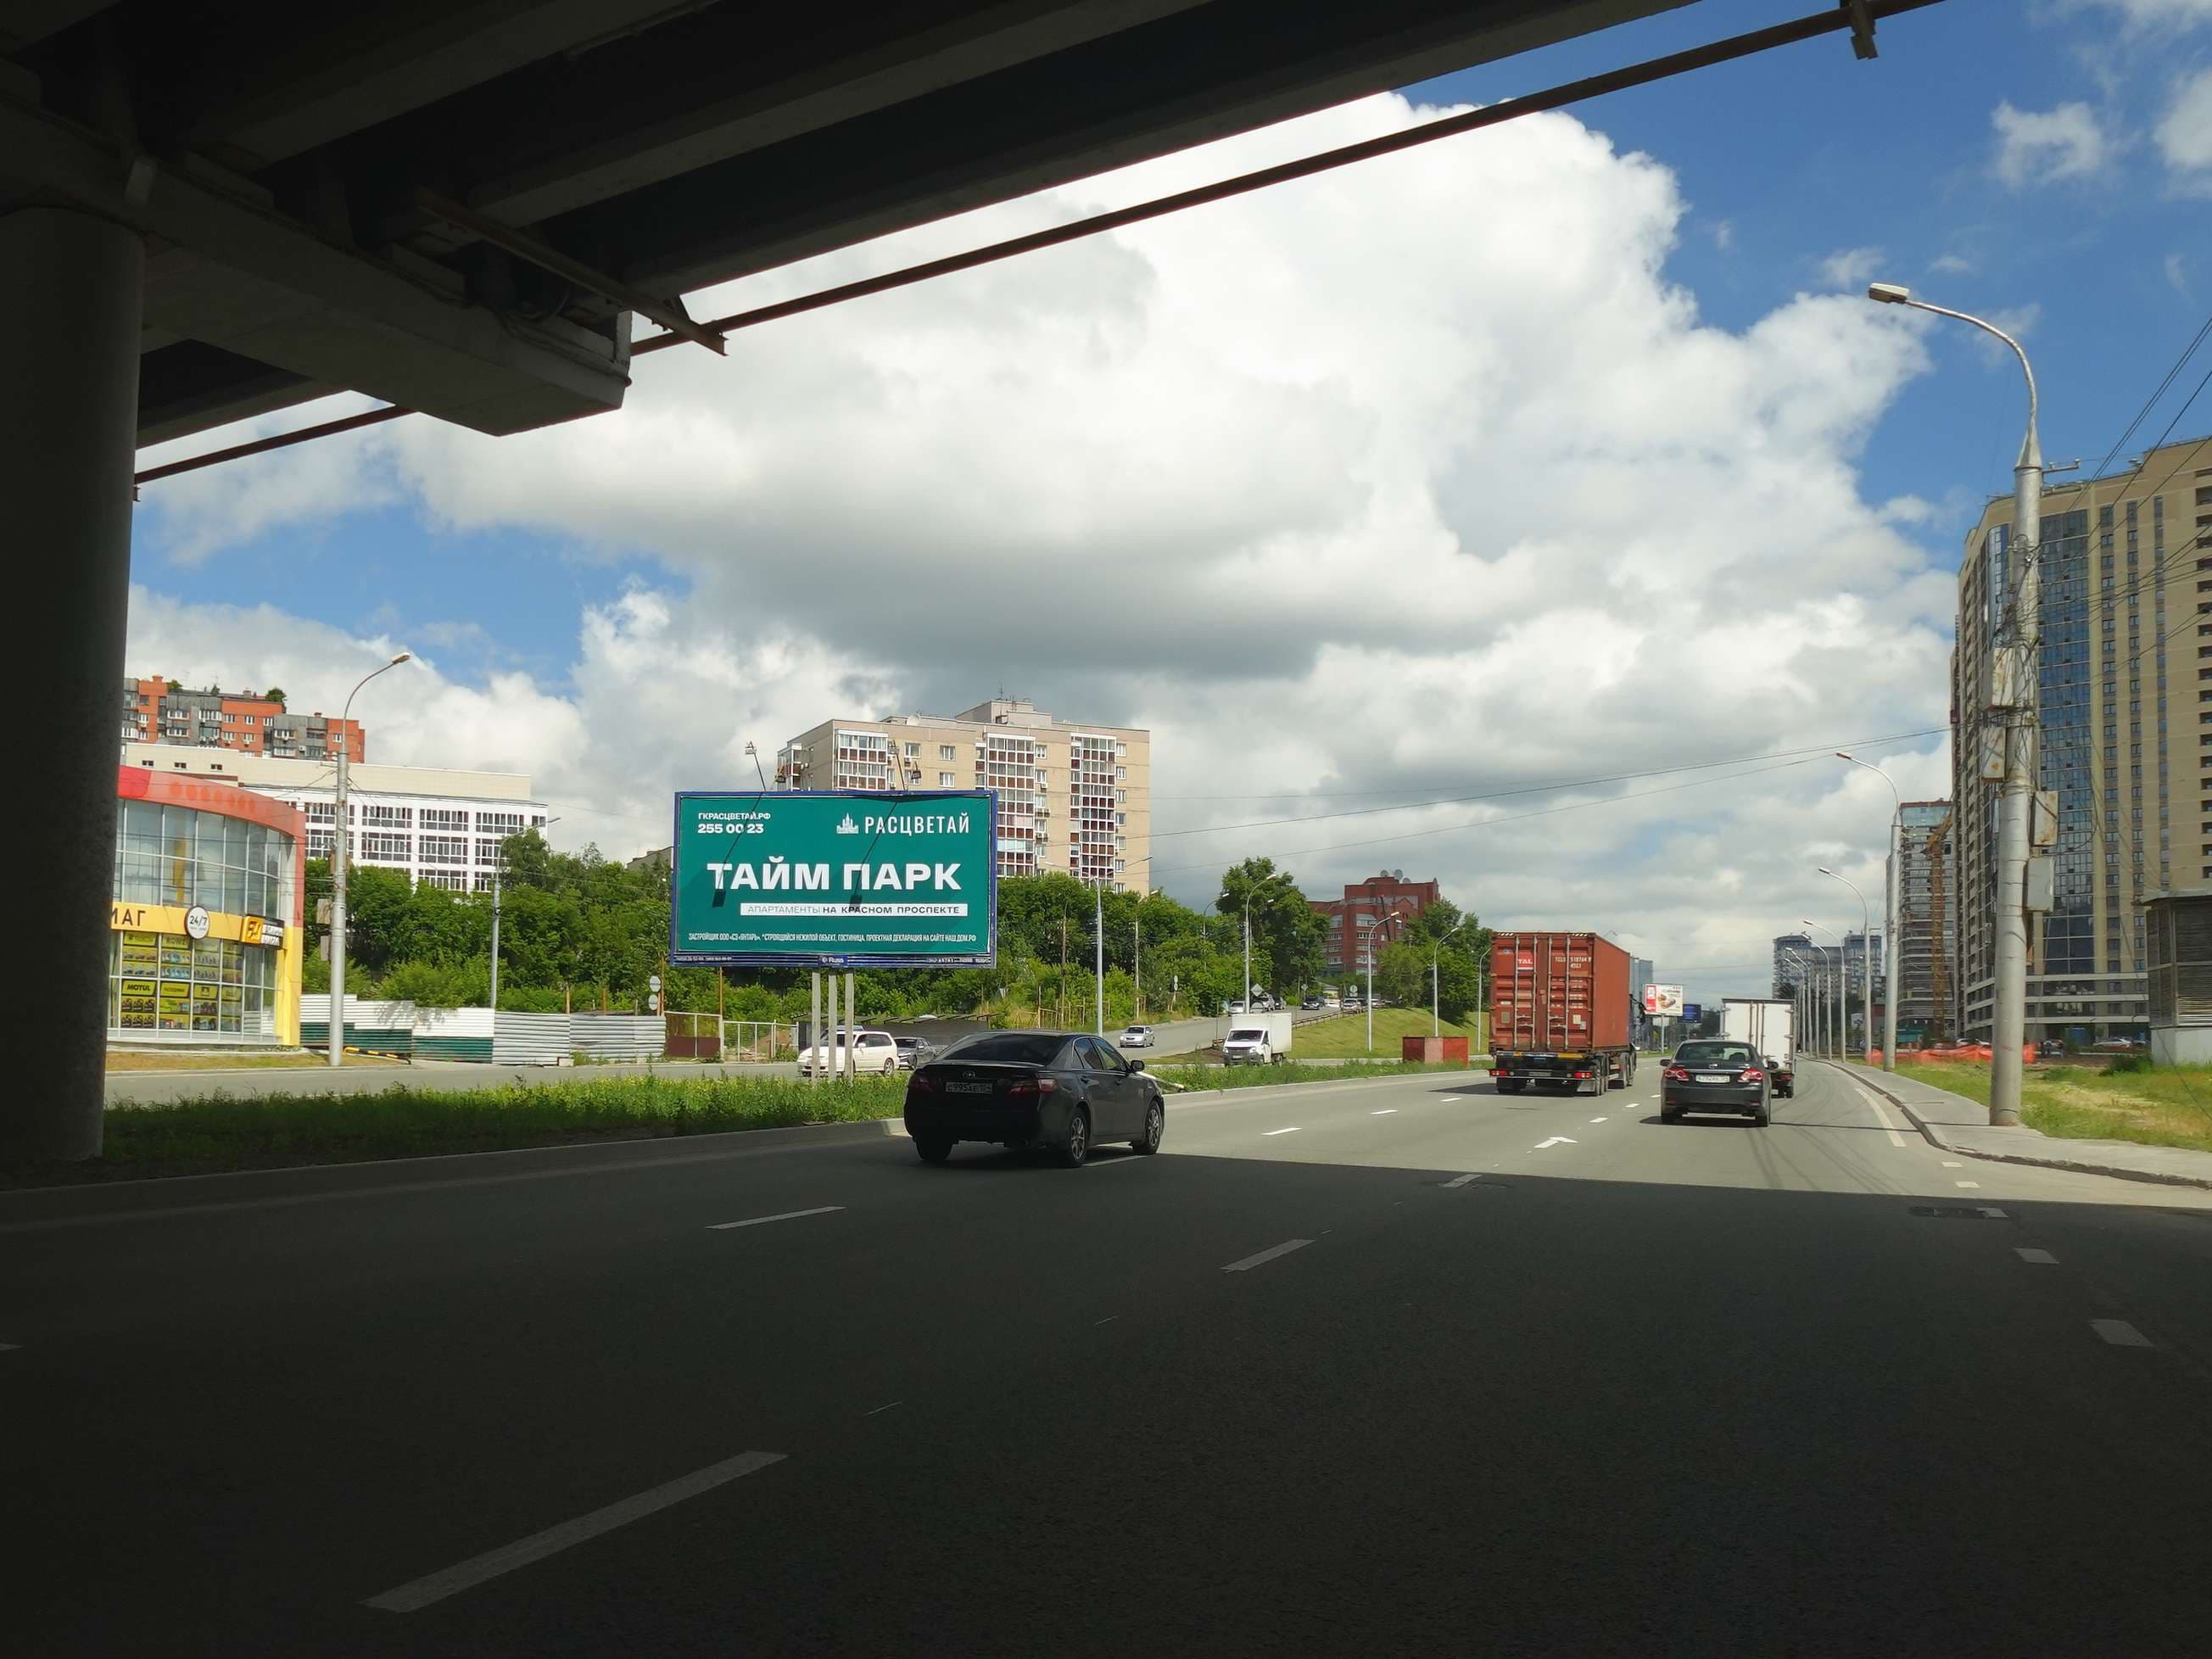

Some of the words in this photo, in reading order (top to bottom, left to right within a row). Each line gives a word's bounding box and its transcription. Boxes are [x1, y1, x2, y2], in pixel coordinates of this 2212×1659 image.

[698, 811, 772, 821] ГКРАСЦВЕТАЙ.РФ
[697, 823, 724, 834] 255
[725, 823, 745, 834] 00
[746, 823, 764, 834] 23
[864, 812, 970, 836] РАСЦВЕТАЙ
[707, 855, 830, 891] ТАЙМ
[843, 863, 962, 891] ПАРК
[747, 905, 821, 914] АПАРТАМЕНТЫ
[822, 906, 837, 914] НА
[841, 906, 893, 914] КРАСНОМ
[897, 906, 960, 914] ПРОСПЕКТЕ
[189, 915, 208, 927] 24/7
[127, 983, 151, 991] MOTUL
